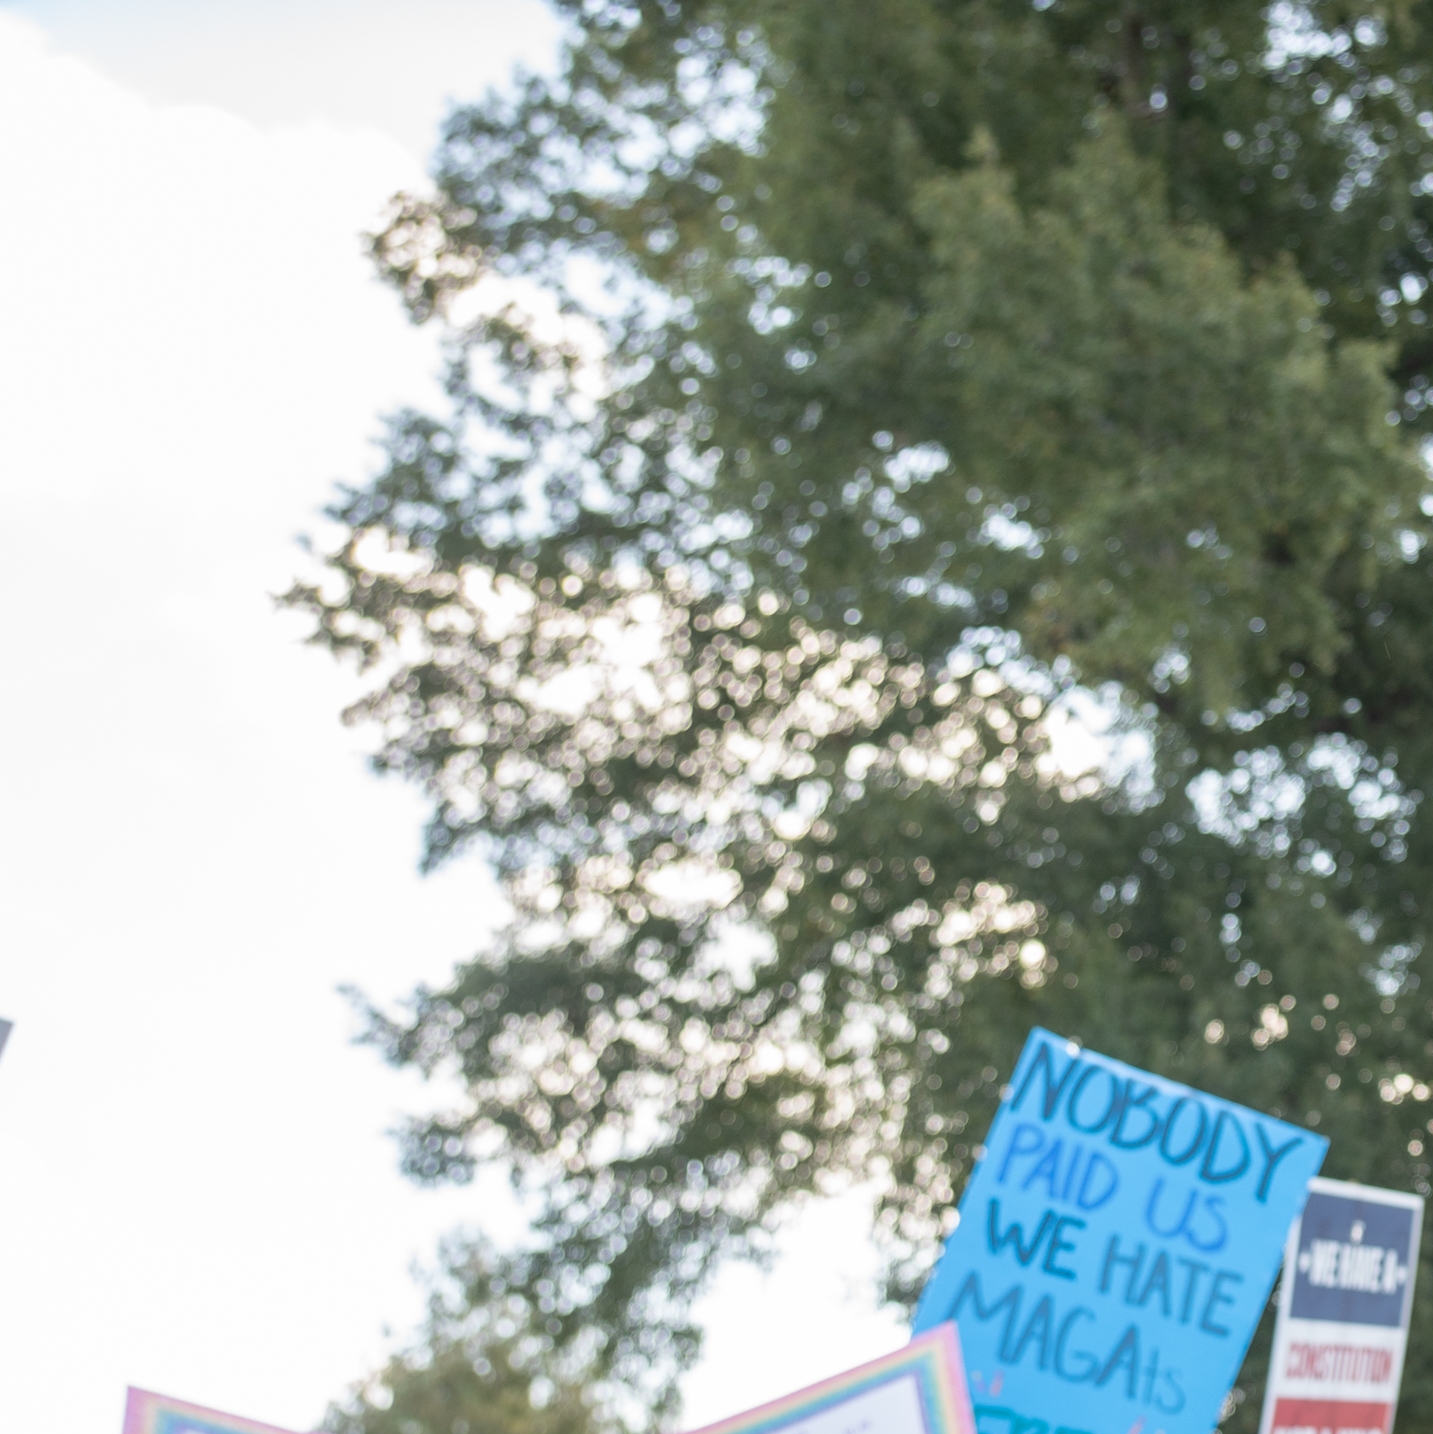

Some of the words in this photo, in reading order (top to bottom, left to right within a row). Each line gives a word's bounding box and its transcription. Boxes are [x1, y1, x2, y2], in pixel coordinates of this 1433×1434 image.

[998, 1121, 1120, 1212] PAID
[1144, 1176, 1228, 1254] US
[1009, 1042, 1304, 1204] NOBODY
[987, 1197, 1088, 1280] WE
[1098, 1232, 1245, 1338] HATE
